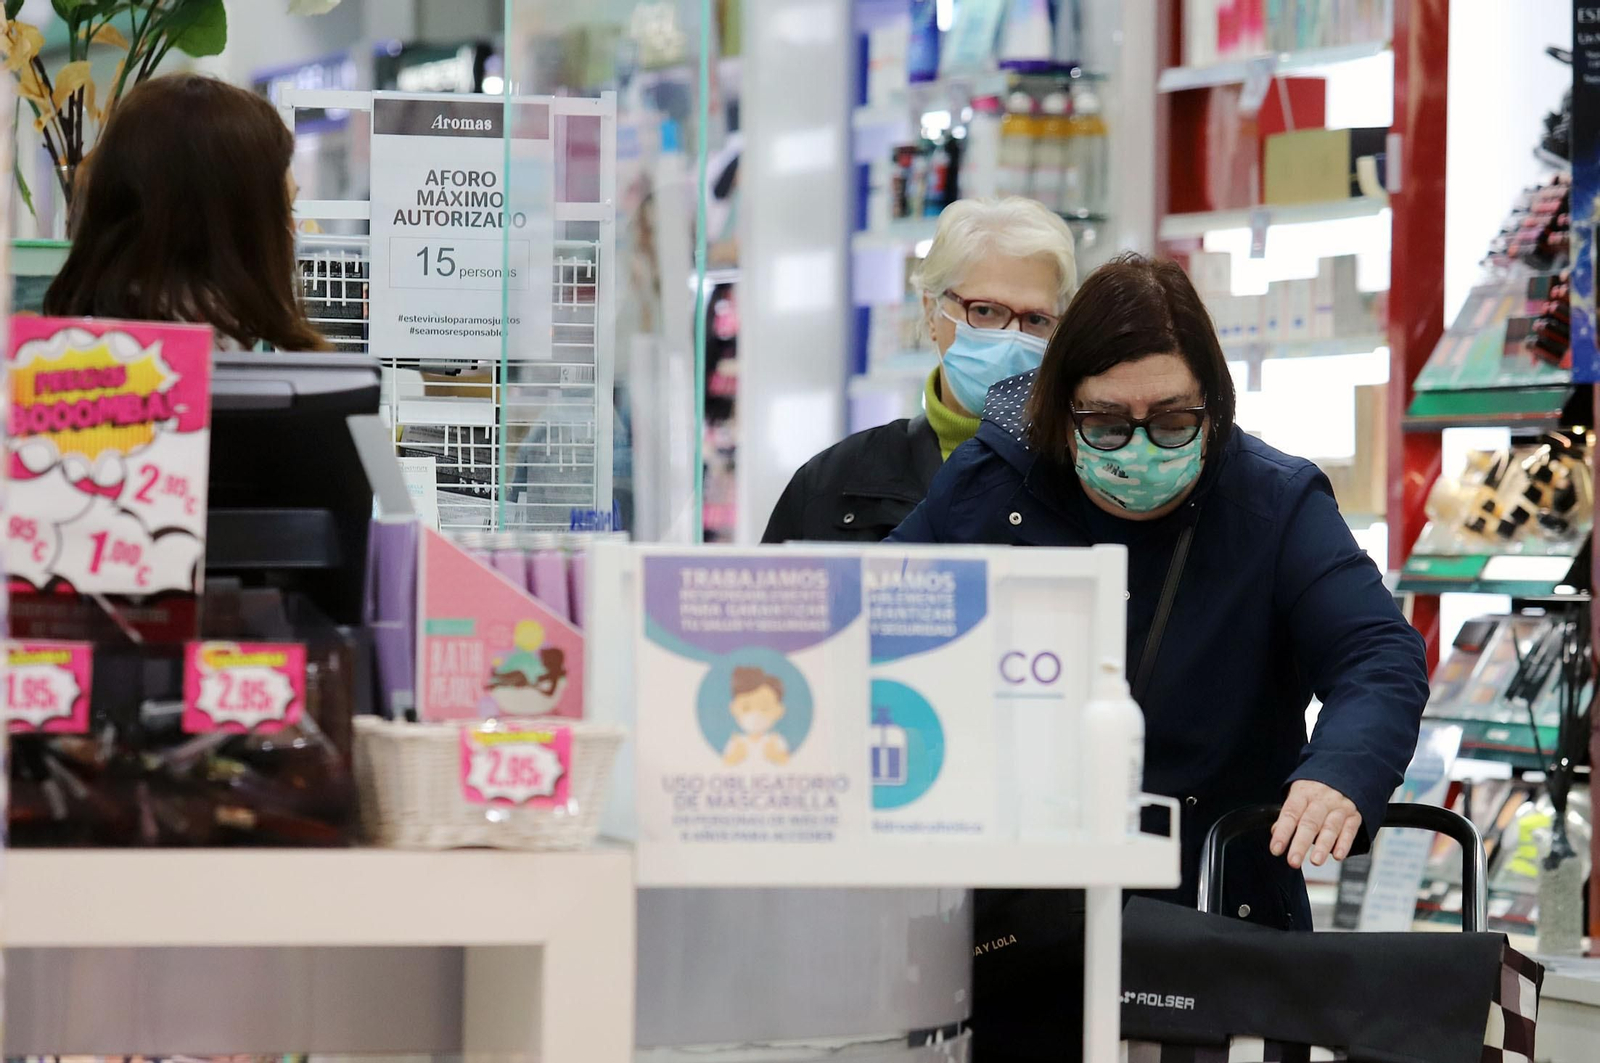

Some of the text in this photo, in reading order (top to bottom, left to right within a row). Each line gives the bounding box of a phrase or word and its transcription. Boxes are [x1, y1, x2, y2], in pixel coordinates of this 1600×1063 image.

[431, 114, 492, 131] Aromas
[425, 169, 497, 188] AFORO
[416, 187, 505, 208] MÁXIMO
[416, 246, 456, 277] 15
[398, 314, 521, 326] #estevirusloparamosjutos
[679, 567, 830, 588] TRABAJAMOS
[680, 603, 722, 617] PARA
[430, 639, 483, 674] BATH
[661, 775, 850, 794] USO OBLIGATORIO
[673, 796, 838, 810] DE MASCARILLA
[982, 942, 990, 953] Y
[992, 934, 1018, 950] LOLA
[1136, 992, 1195, 1010] ROLSER
